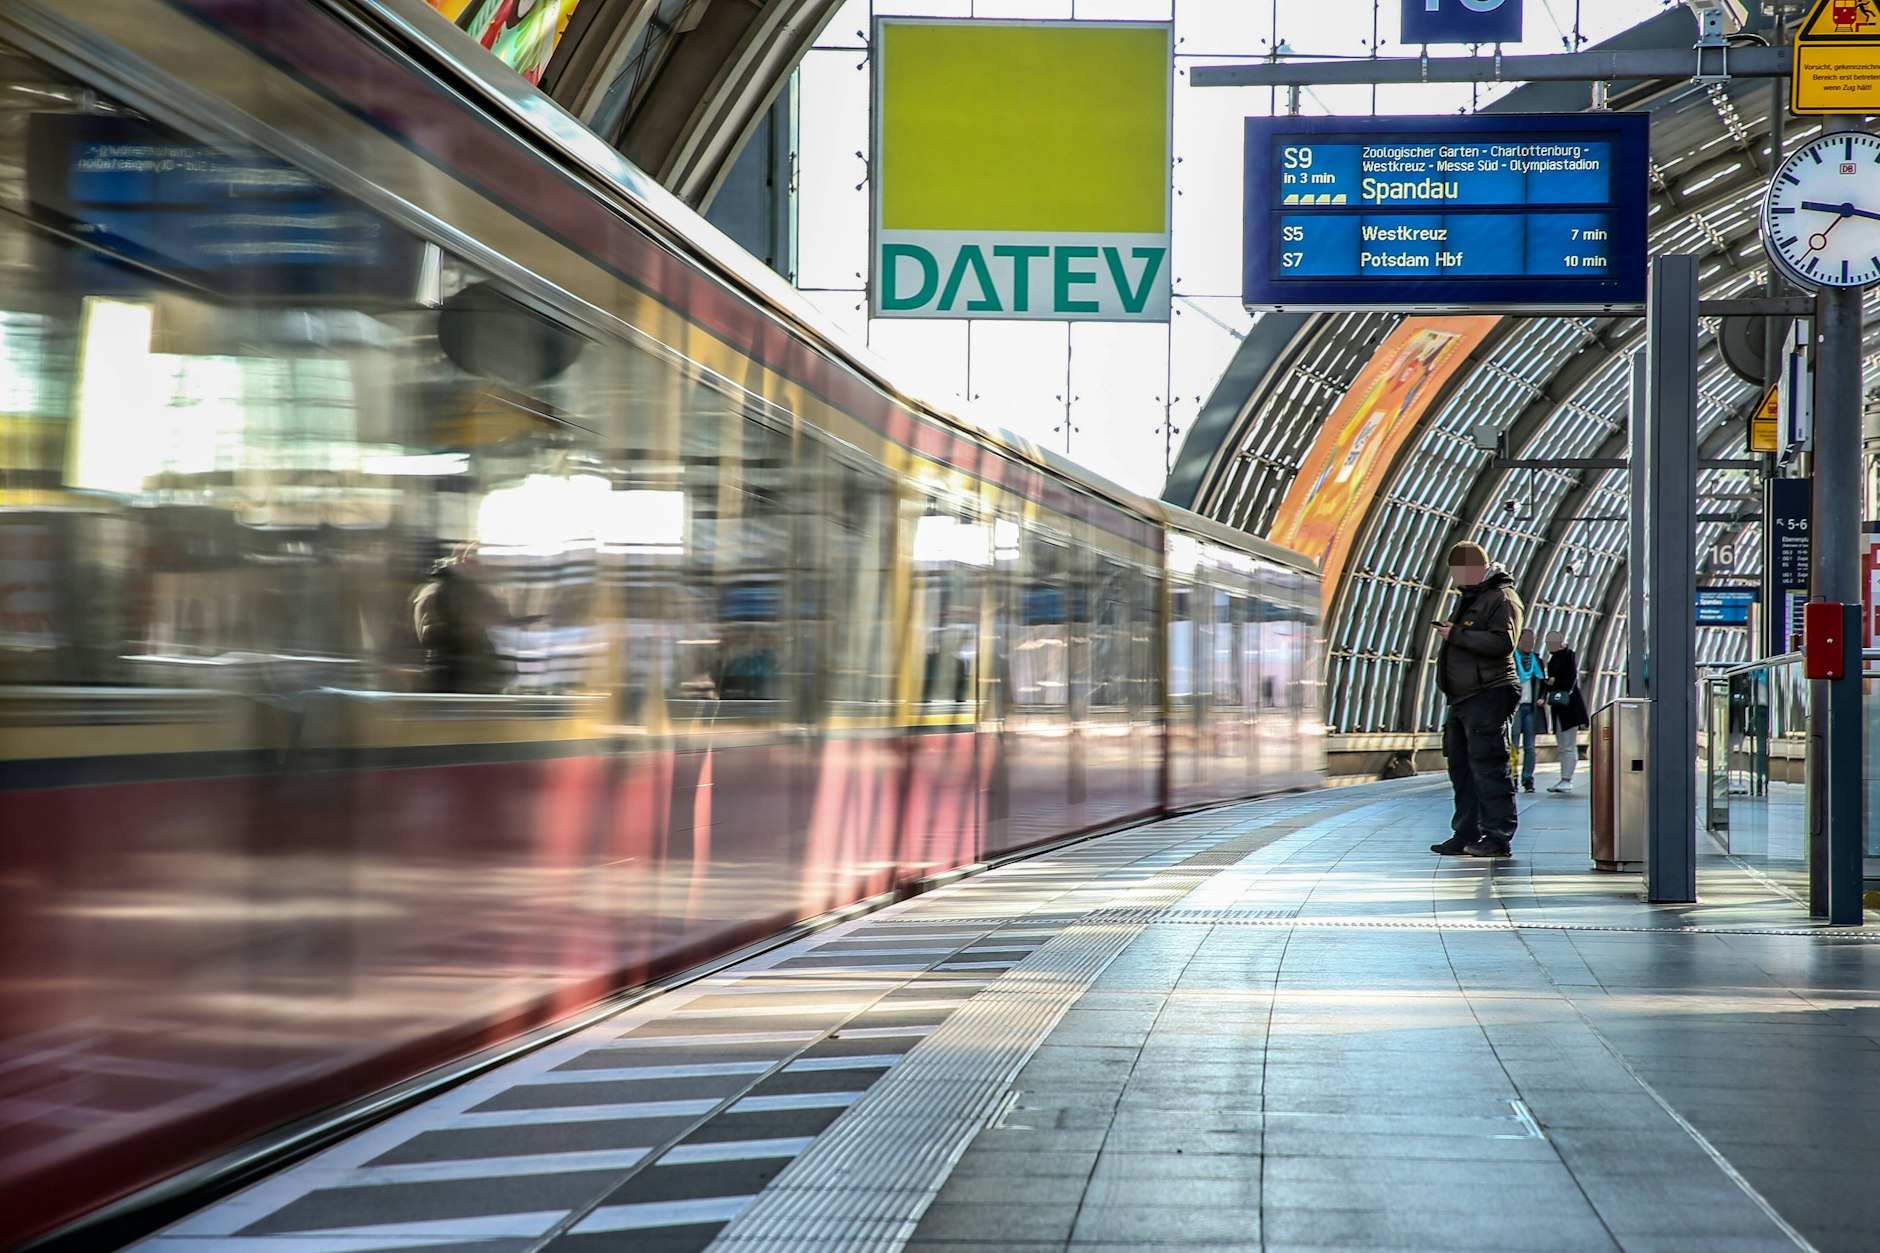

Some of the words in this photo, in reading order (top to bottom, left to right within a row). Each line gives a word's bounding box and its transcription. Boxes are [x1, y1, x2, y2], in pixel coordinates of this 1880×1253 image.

[1283, 148, 1313, 168] S9
[1363, 147, 1436, 160] Zoologischer
[1439, 146, 1479, 158] Garten
[1490, 146, 1580, 159] Charlottenburg
[1363, 160, 1426, 172] Westkreuz
[1437, 160, 1475, 171] Messe
[1478, 160, 1499, 171] Süd
[1510, 159, 1600, 173] Olympiastadion
[1842, 165, 1854, 173] DB
[1284, 173, 1297, 184] in
[1300, 173, 1308, 184] 3
[1312, 173, 1336, 184] min
[1362, 177, 1458, 205] Spandau
[1283, 227, 1304, 241] S5
[1362, 226, 1447, 241] Westkreuz
[1571, 229, 1579, 241] 7
[1583, 229, 1607, 240] min
[1283, 253, 1304, 267] S7
[1361, 252, 1429, 268] Potsdam
[1435, 252, 1464, 267] Hbf
[1564, 255, 1578, 267] 10
[1583, 255, 1607, 267] min
[881, 243, 1167, 313] DATEV
[1787, 518, 1808, 530] 5-6
[1710, 544, 1733, 565] 16
